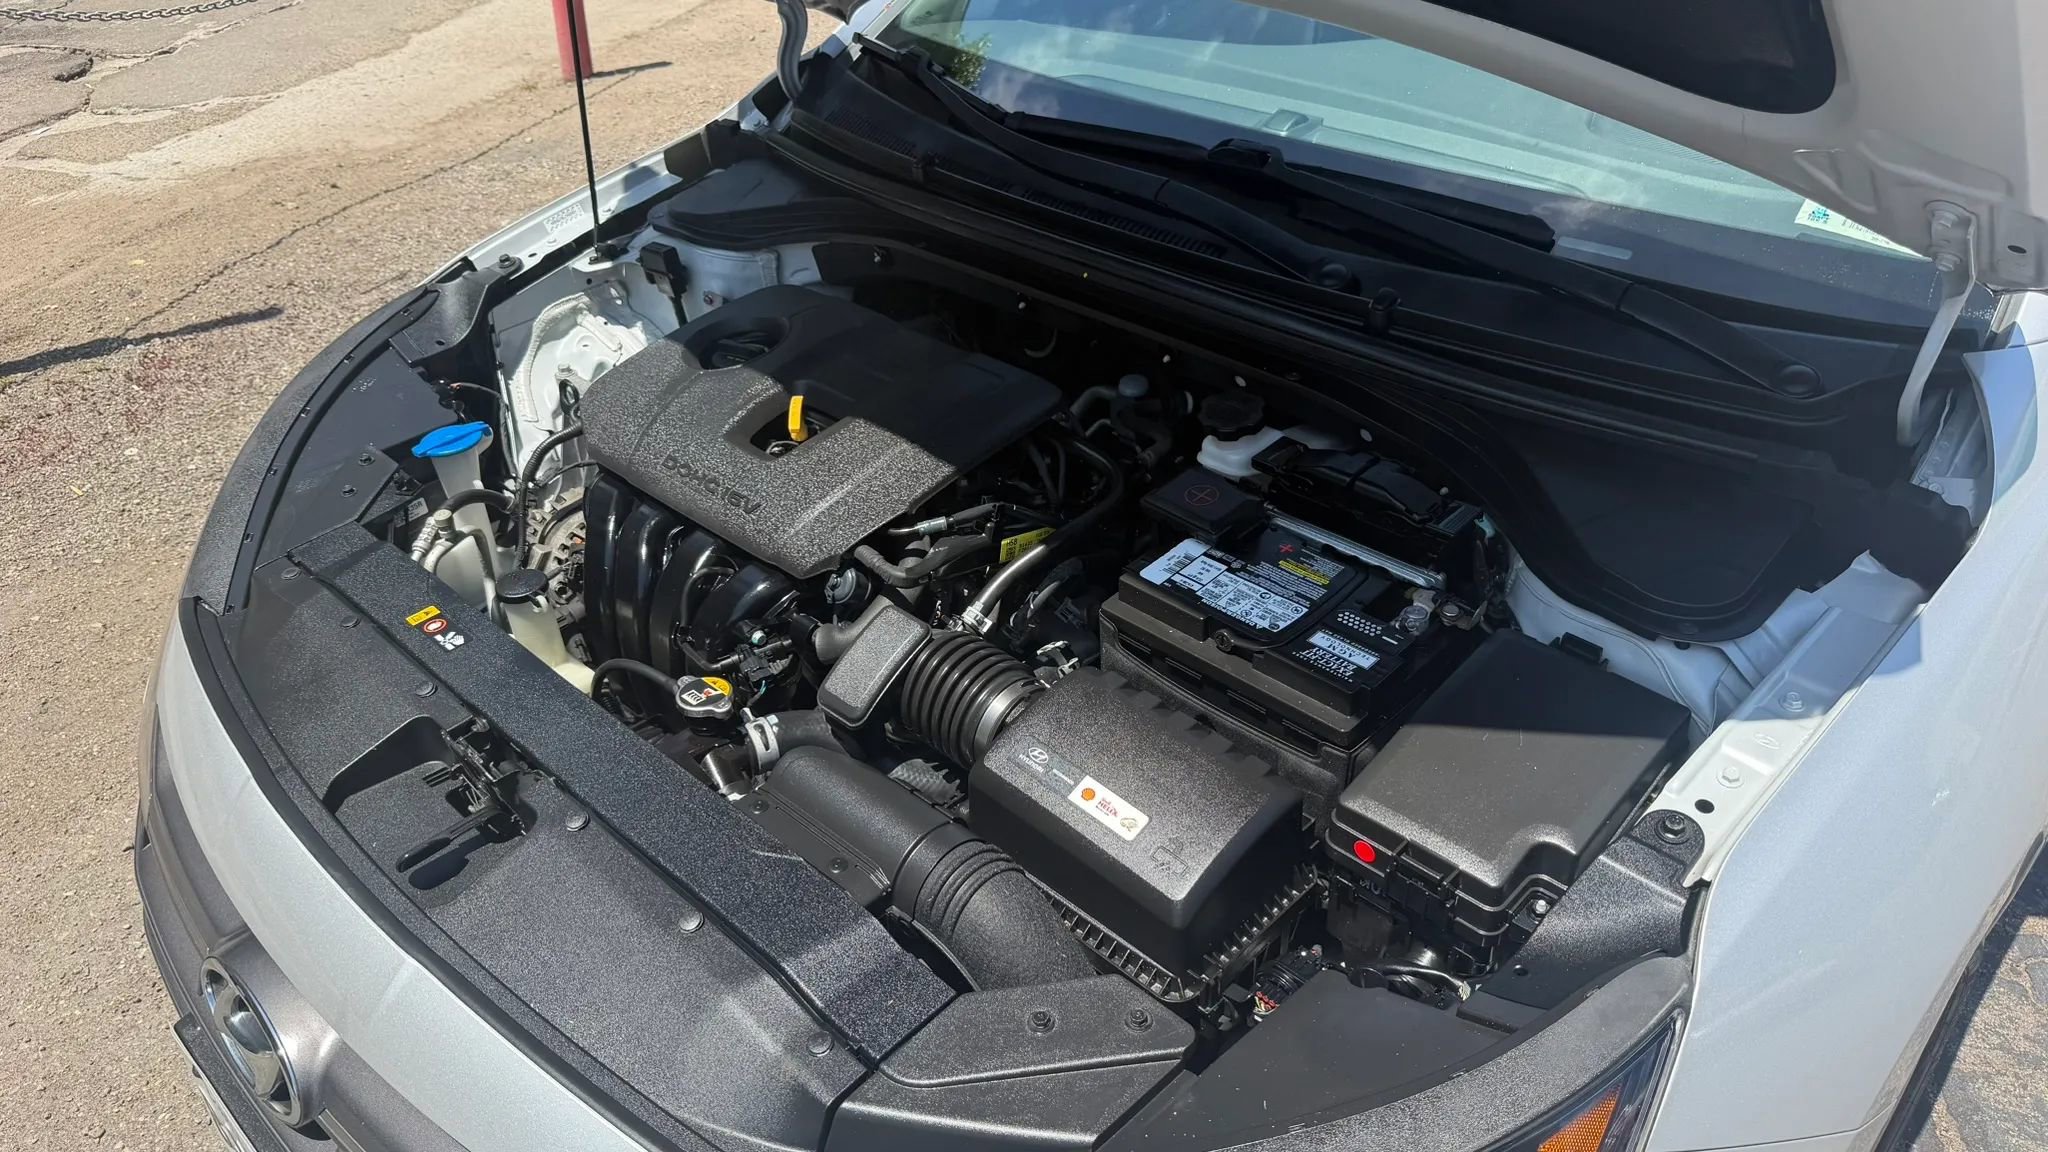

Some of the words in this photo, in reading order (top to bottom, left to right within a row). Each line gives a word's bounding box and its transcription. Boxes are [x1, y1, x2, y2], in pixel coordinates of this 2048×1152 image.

[1320, 635, 1370, 660] TECHNOLOGY
[1326, 643, 1355, 658] AGM
[1299, 649, 1354, 676] EXACT-FIT
[1310, 647, 1357, 670] BATTERY
[1018, 753, 1044, 773] HYUNDAI
[1097, 799, 1120, 817] HELIX
